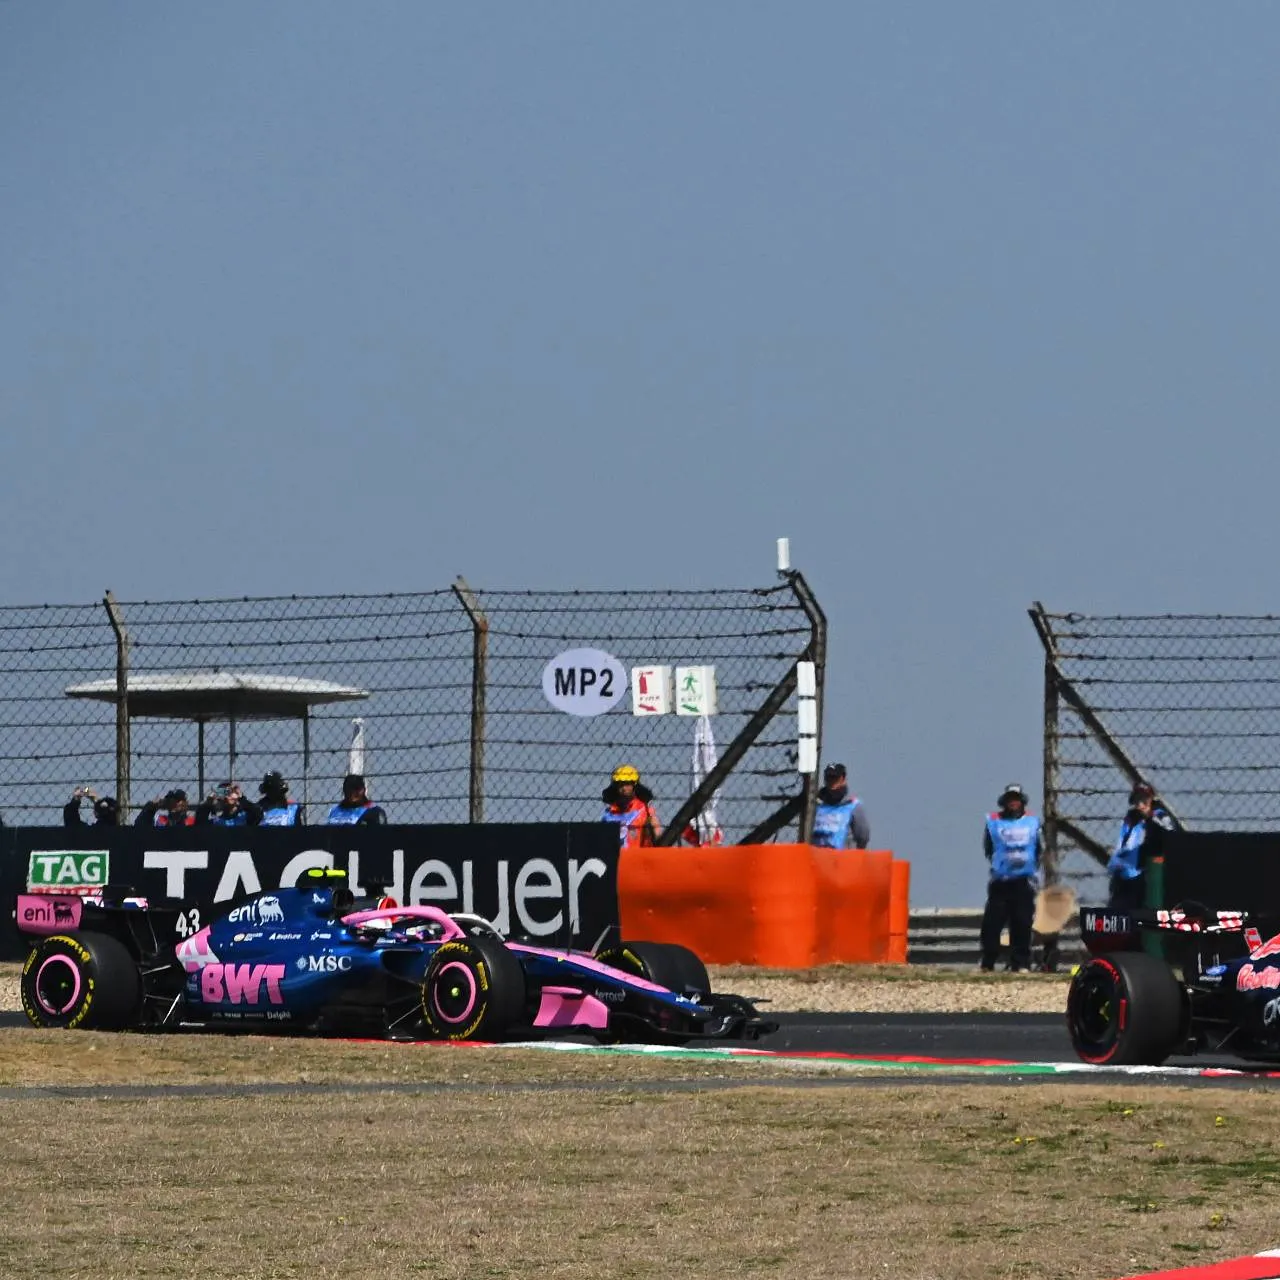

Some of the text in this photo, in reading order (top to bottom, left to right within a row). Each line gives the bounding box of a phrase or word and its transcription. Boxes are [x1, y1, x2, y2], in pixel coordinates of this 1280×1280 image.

[555, 668, 613, 697] MP2
[35, 857, 102, 884] TAG
[24, 902, 51, 922] eni
[175, 908, 200, 938] 43
[229, 898, 257, 923] eni
[1085, 913, 1118, 933] Mobil
[308, 955, 352, 972] MSC
[201, 963, 286, 1005] BWT
